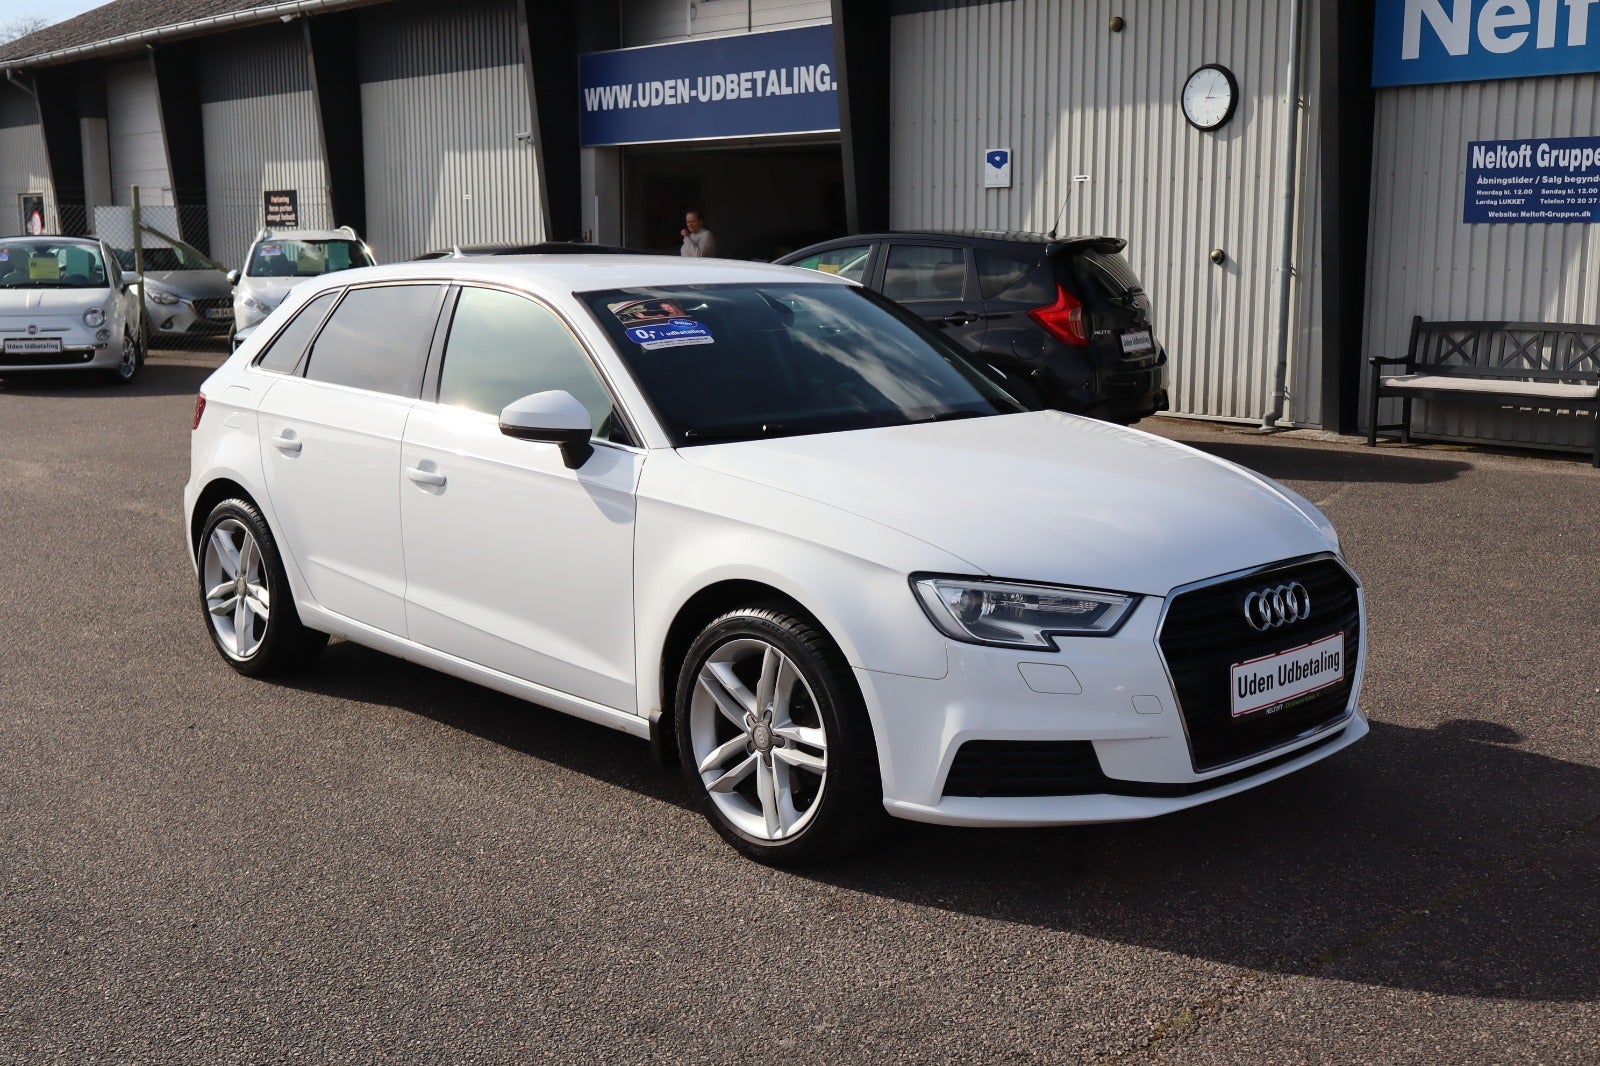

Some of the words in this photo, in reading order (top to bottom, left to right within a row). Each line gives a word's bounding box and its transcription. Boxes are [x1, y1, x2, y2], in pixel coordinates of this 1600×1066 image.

[584, 64, 838, 112] WWW.UDEN-UDBETALING.
[1472, 144, 1532, 169] Neltoft
[1477, 175, 1533, 186] Åbningstider
[1542, 175, 1562, 185] Salg
[1520, 210, 1592, 218] Neltoft-Gruppen.dk
[1238, 673, 1274, 699] Uden
[1278, 650, 1341, 687] Udbetaling
